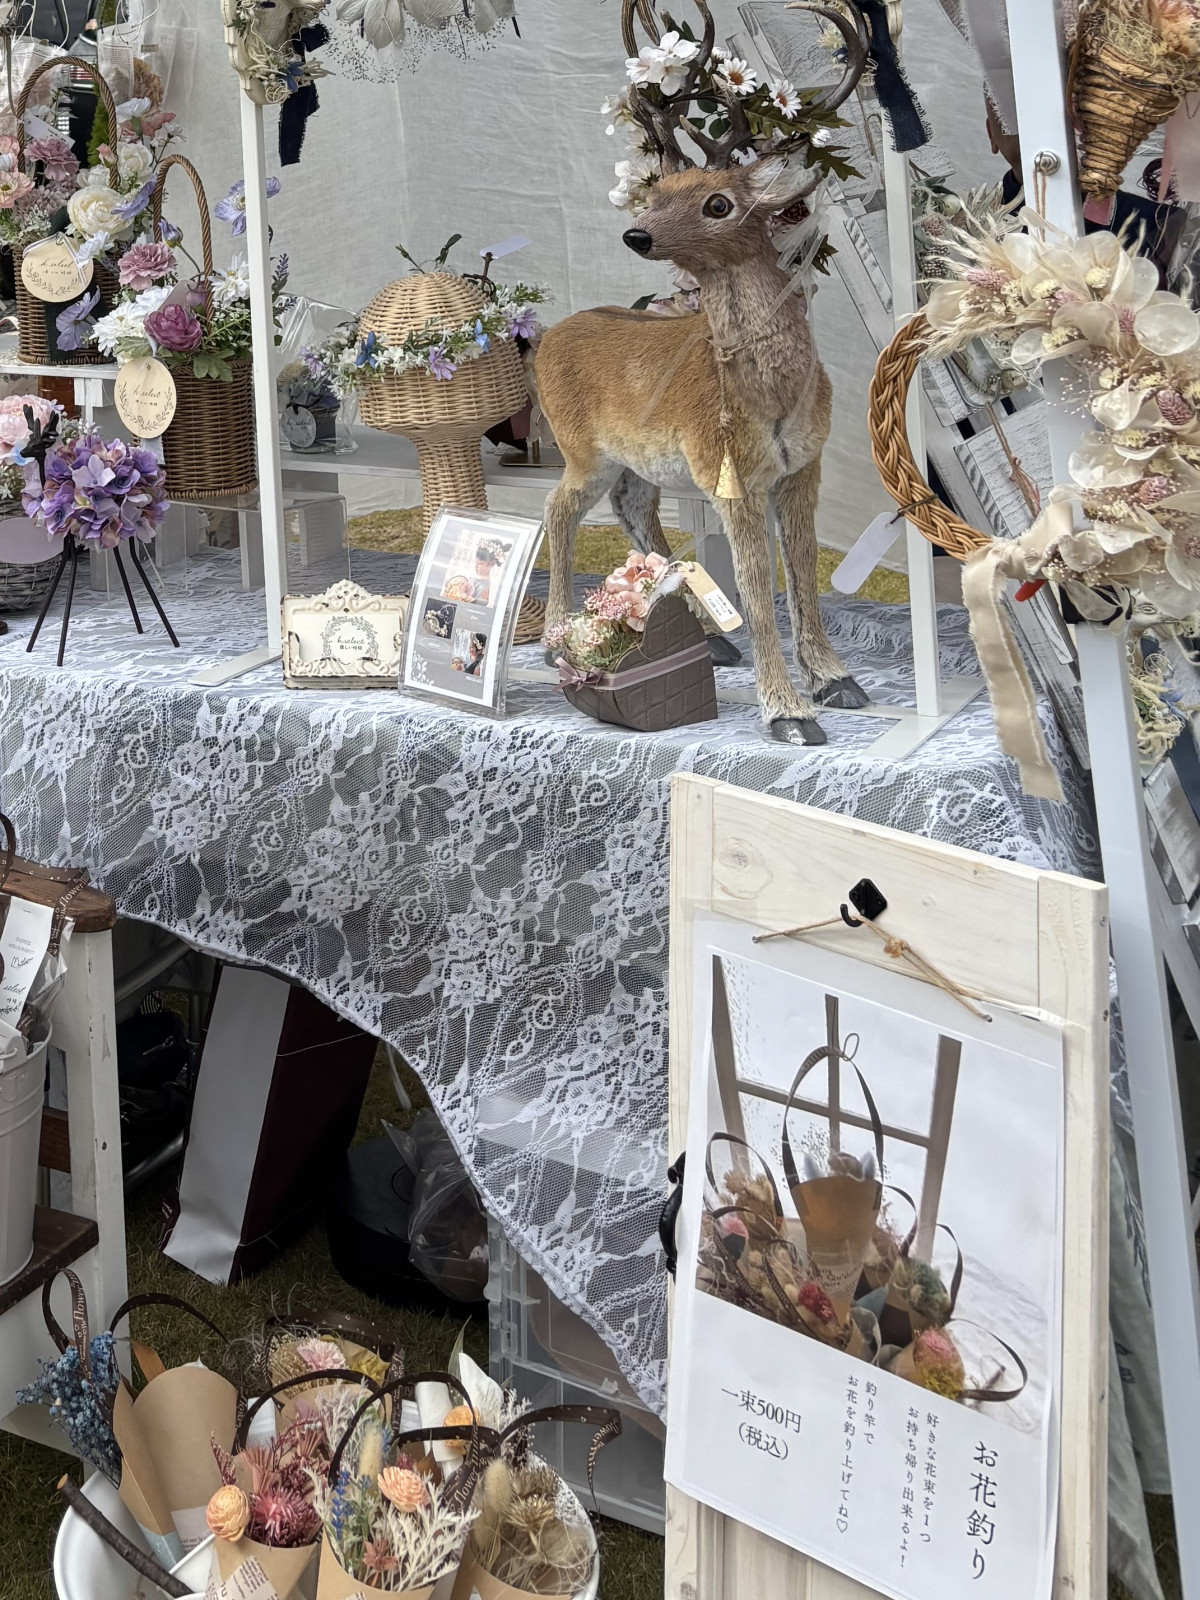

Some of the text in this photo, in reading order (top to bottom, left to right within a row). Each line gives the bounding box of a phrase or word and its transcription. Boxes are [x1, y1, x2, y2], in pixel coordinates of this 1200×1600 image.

[59, 882, 84, 908] flower
[73, 1287, 86, 1322] flower
[720, 1388, 803, 1434] 一束500円
[863, 1380, 878, 1445] 釣り竿で
[738, 1421, 789, 1461] (税込)
[454, 1465, 479, 1503] flower
[966, 1440, 999, 1580] お花釣り
